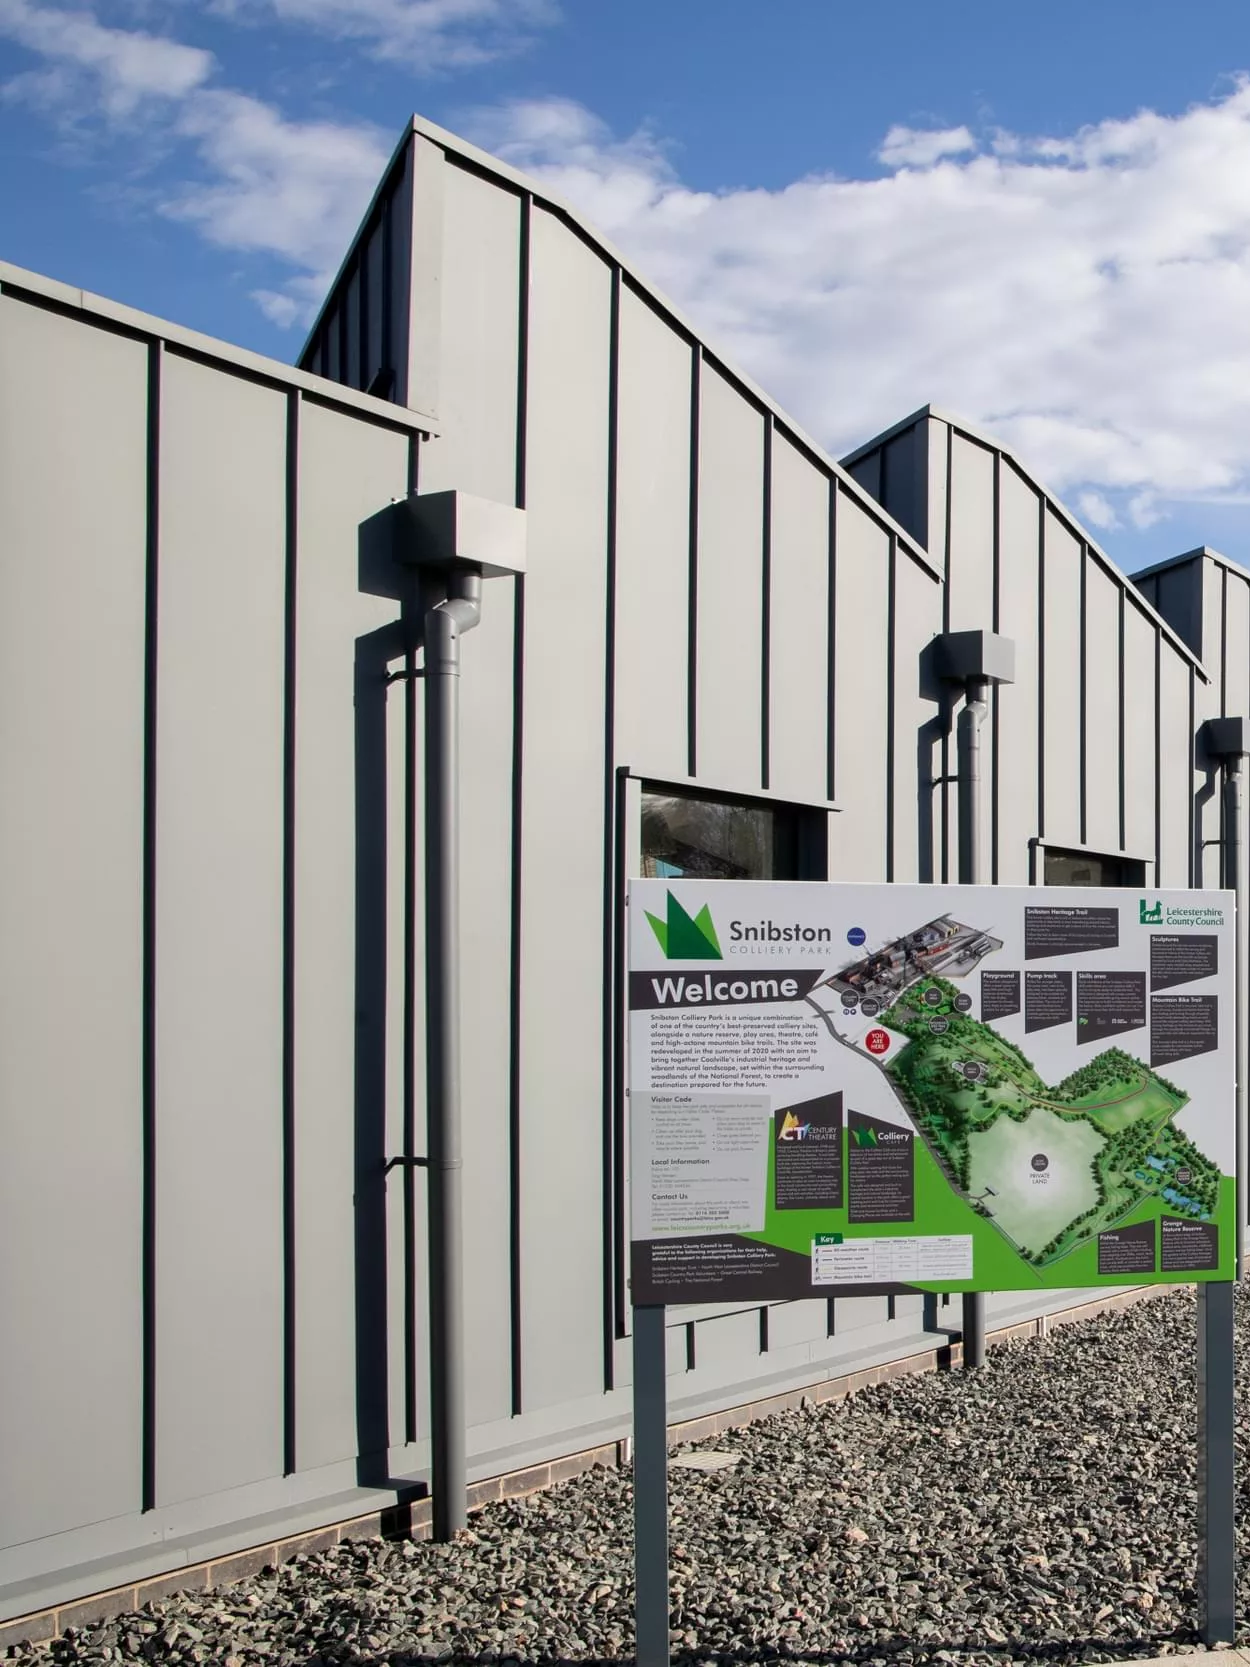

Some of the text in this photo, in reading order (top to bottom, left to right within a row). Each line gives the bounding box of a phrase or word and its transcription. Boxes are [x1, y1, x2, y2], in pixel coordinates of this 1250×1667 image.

[1166, 908, 1223, 917] Leicestershire
[1166, 917, 1224, 926] County Council
[729, 921, 831, 942] Snibston
[729, 946, 832, 954] COLLIERY PARK
[651, 974, 798, 1004] Welcome
[878, 1132, 910, 1142] Colliery
[820, 1236, 834, 1244] Key
